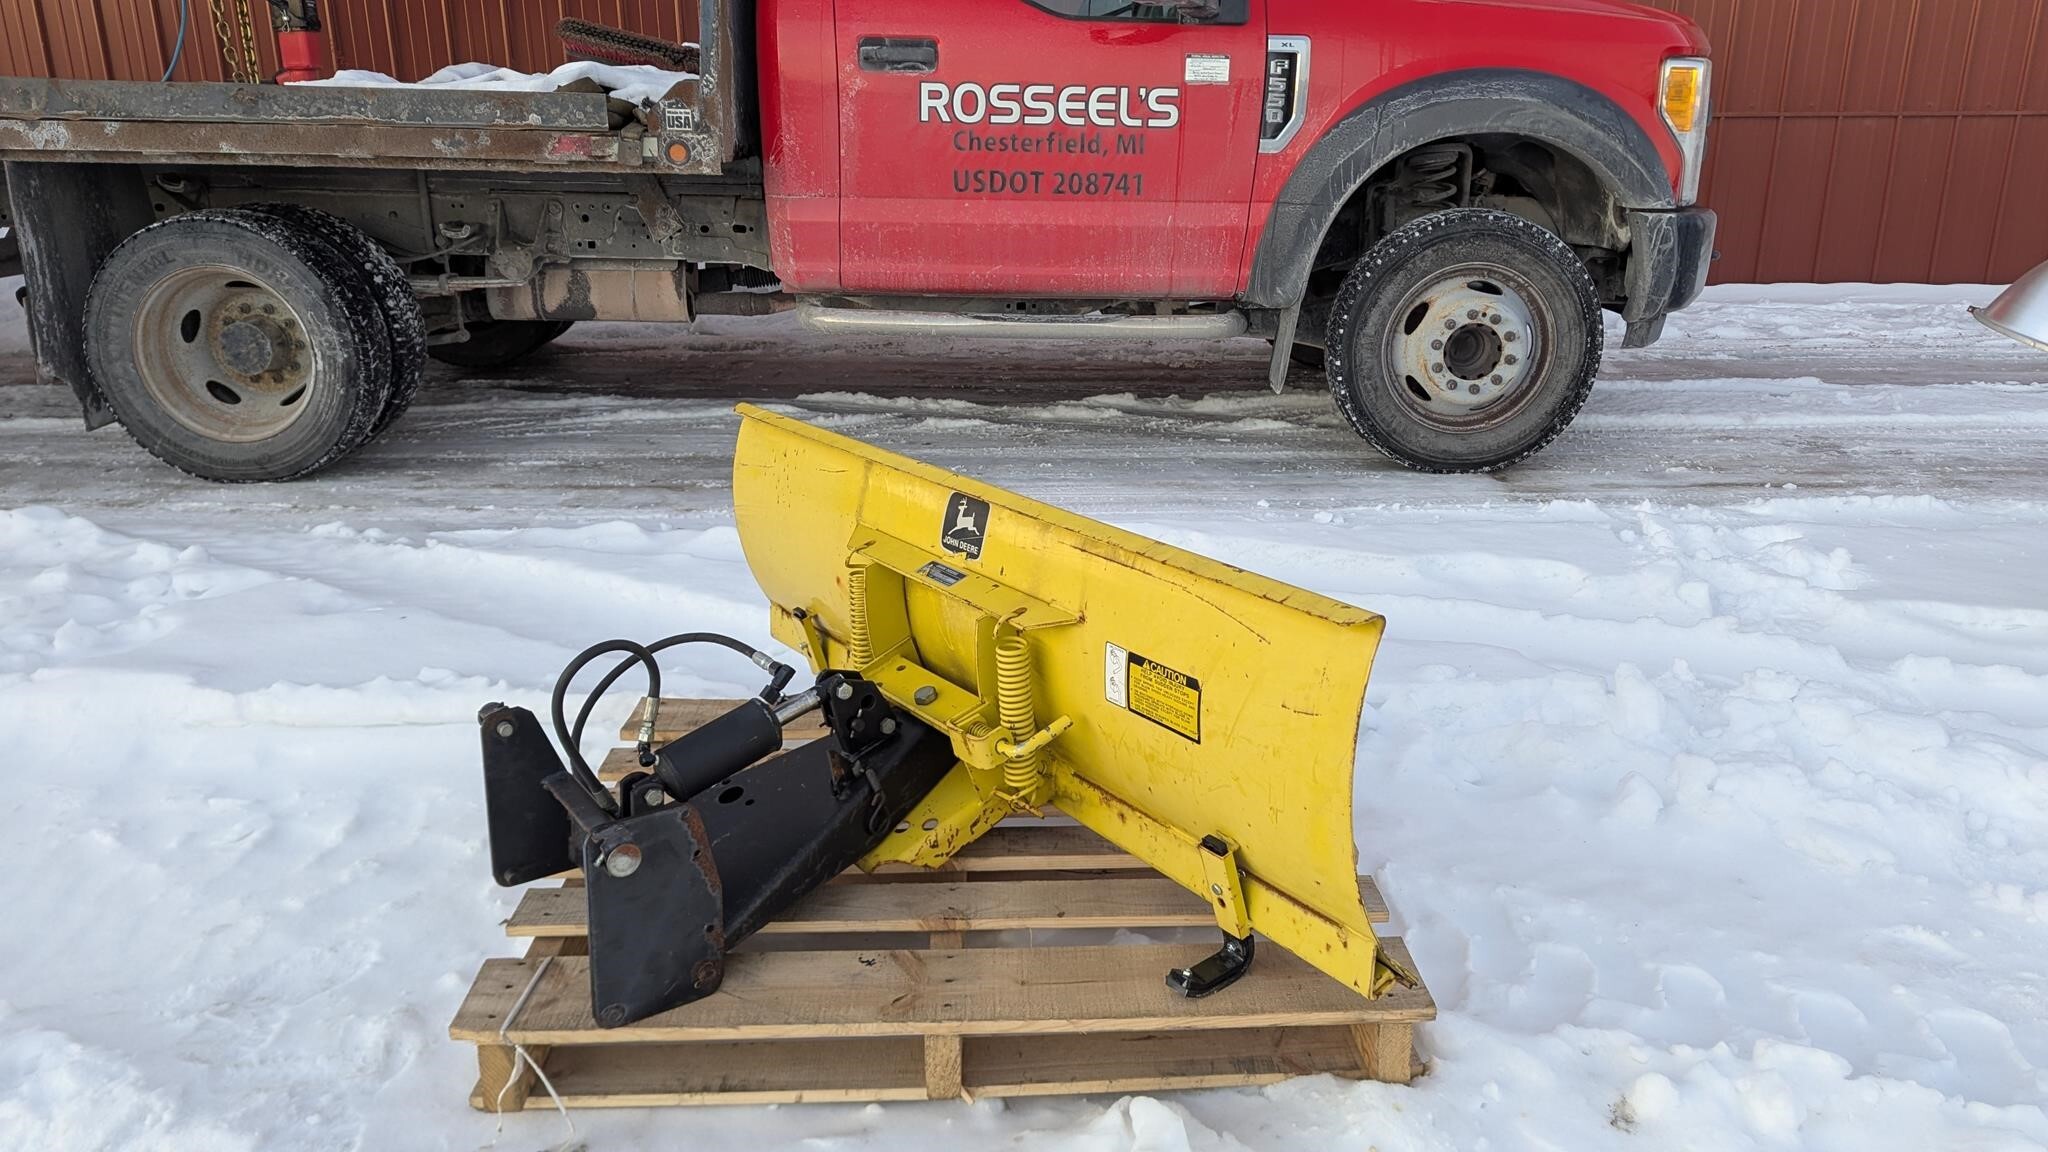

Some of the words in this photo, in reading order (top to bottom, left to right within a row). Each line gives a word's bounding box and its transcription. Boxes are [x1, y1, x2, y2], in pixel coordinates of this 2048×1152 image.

[919, 81, 1180, 128] ROSSEEL'S
[667, 116, 691, 128] USA
[953, 129, 1108, 157] Chesterfield,
[1116, 133, 1145, 155] MI
[953, 170, 1044, 194] USDOT
[1052, 172, 1144, 196] 208741
[943, 535, 959, 548] JOHN
[960, 541, 979, 554] DEERE
[1150, 662, 1187, 686] CAUTION
